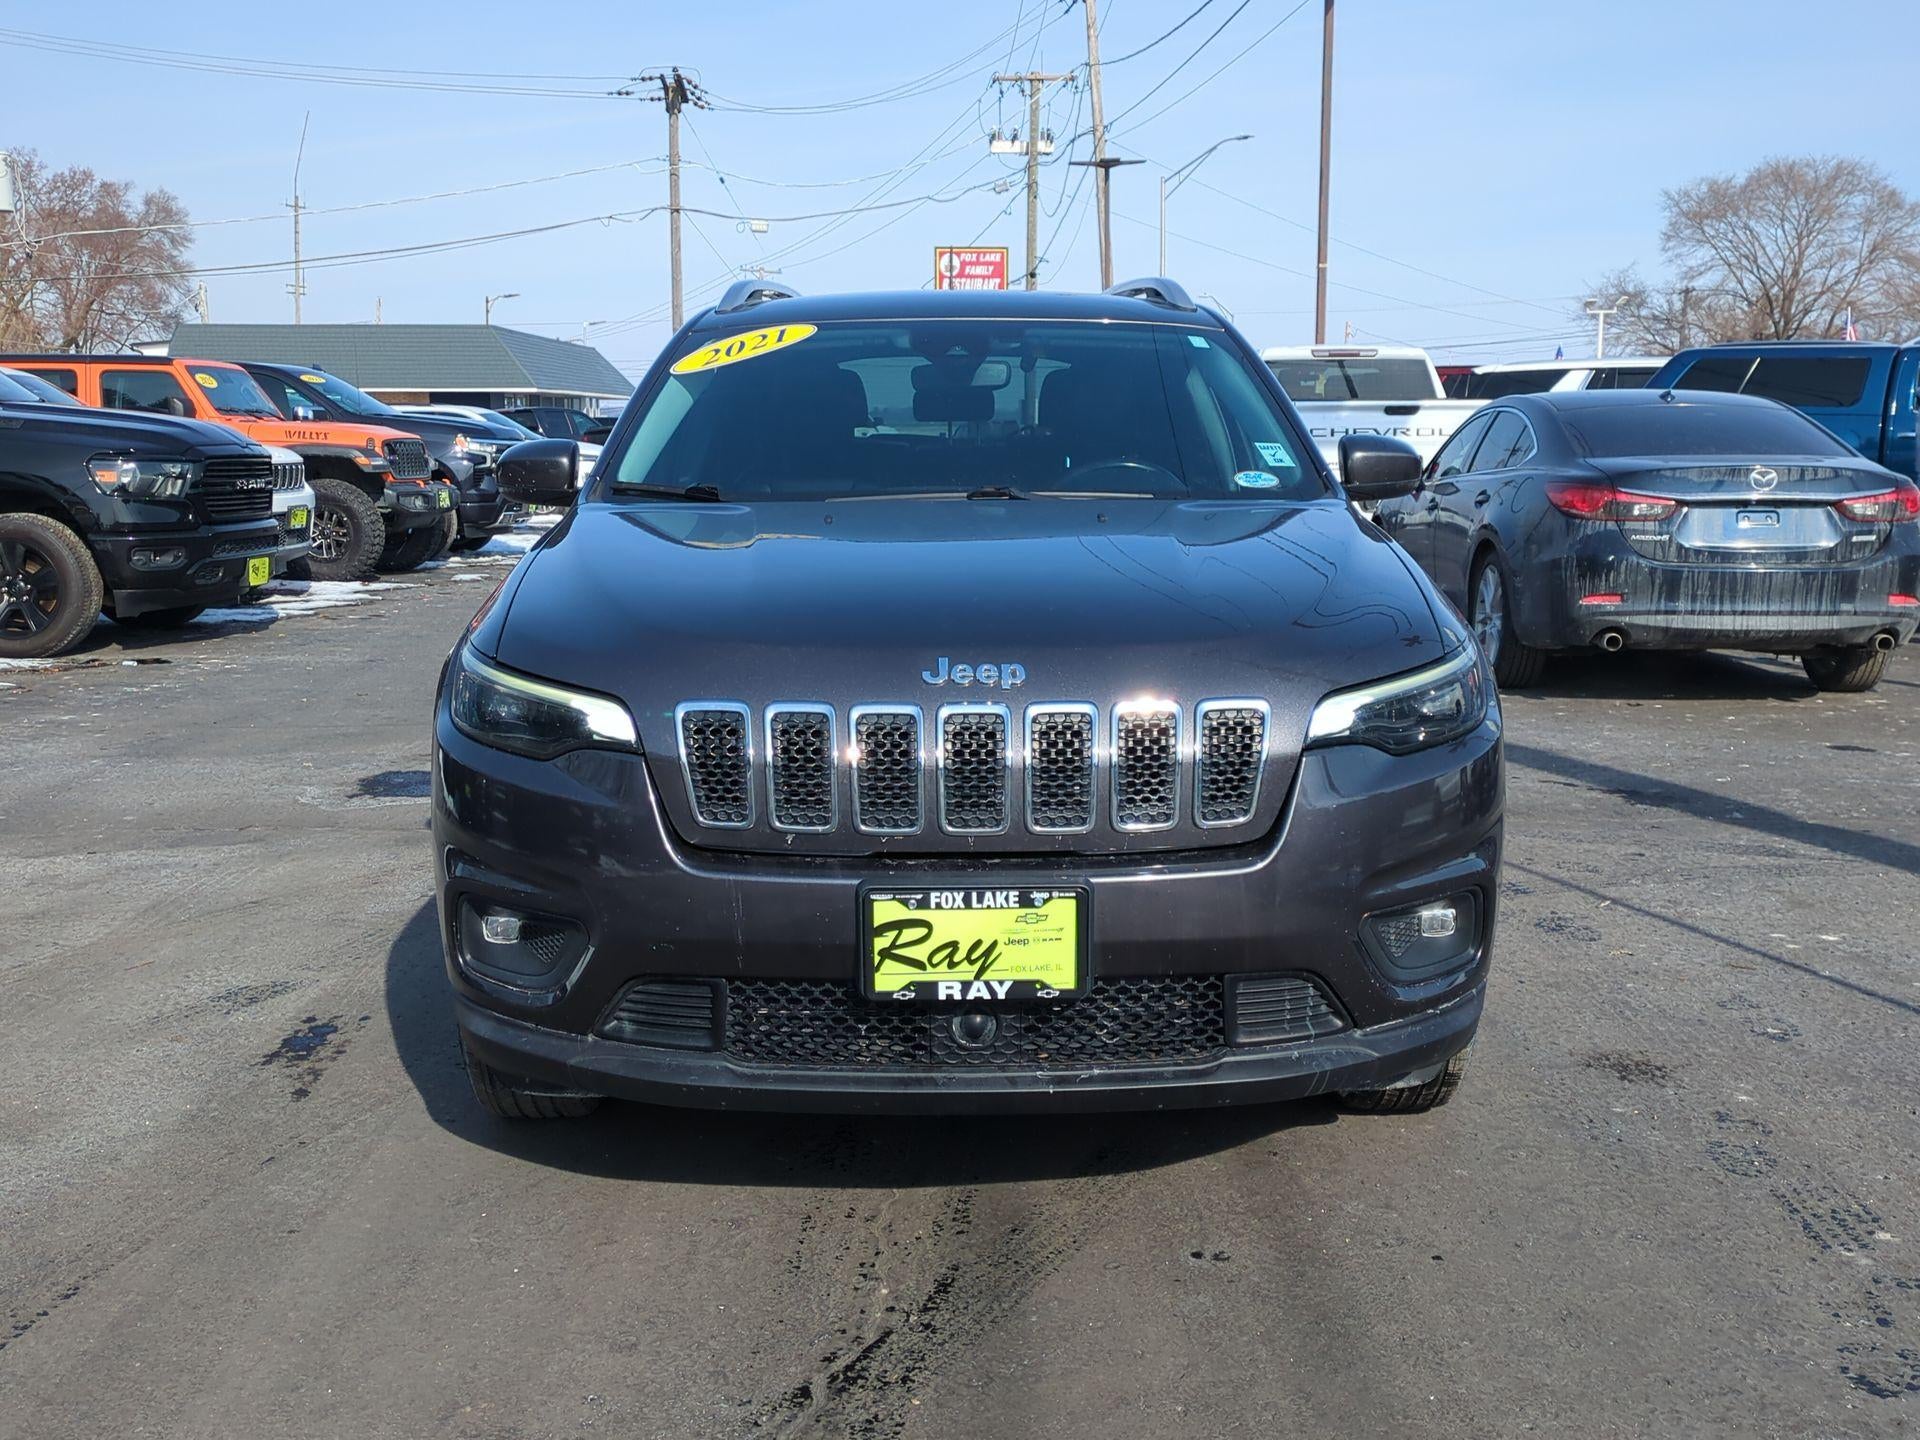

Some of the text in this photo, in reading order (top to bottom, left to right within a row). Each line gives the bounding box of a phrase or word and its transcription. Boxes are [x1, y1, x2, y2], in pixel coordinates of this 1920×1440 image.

[960, 253, 1002, 262] FOX LAKE
[965, 265, 995, 276] FAMILY
[701, 327, 787, 367] 2021
[284, 430, 330, 441] WILLYS
[236, 479, 265, 489] RAM
[921, 657, 1026, 691] Jeep
[930, 891, 1020, 909] FOX LAKE
[1030, 891, 1050, 900] Jeep
[1003, 936, 1030, 947] Jeep
[873, 918, 1003, 980] Ray
[1010, 965, 1027, 973] FOX
[1055, 963, 1064, 972] IL
[937, 981, 1014, 1001] RAY
